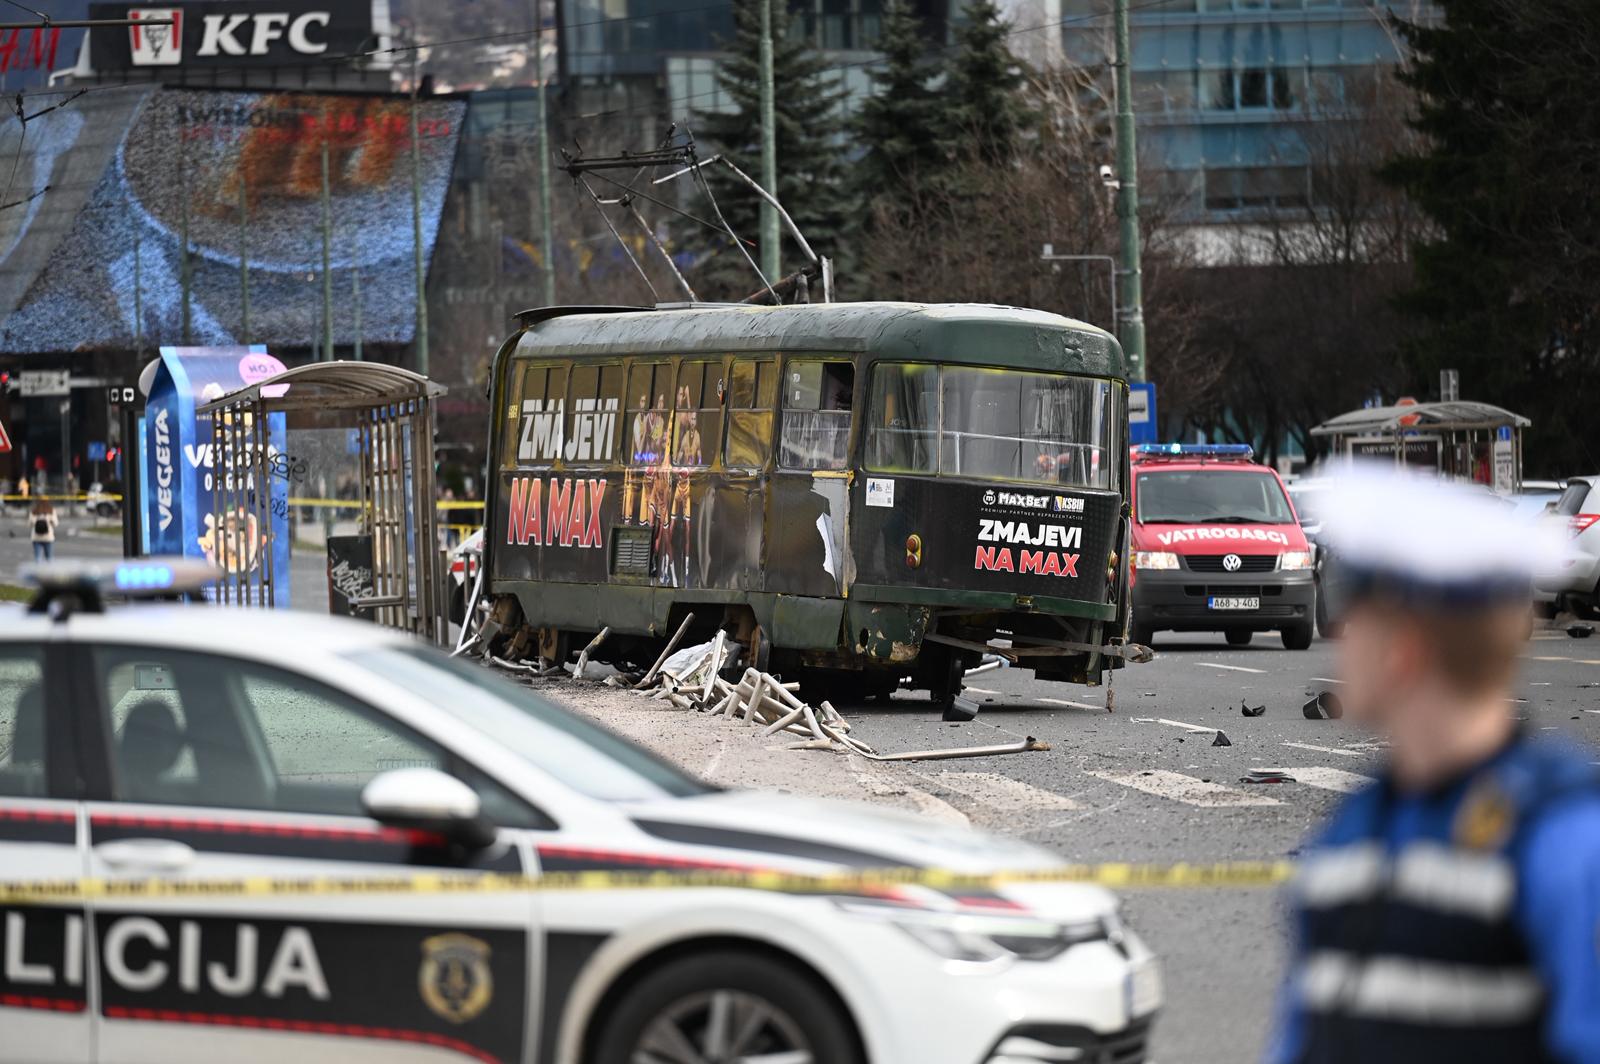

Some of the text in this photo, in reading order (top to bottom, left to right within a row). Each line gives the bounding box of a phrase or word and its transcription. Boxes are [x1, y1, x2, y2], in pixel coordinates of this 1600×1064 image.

[196, 12, 330, 56] KFC
[518, 398, 619, 462] ZMAJEVI
[155, 408, 174, 532] VEGETA
[507, 477, 607, 548] NA MAX
[978, 519, 1082, 549] ZMAJEVI
[1157, 528, 1289, 545] VATROGASCI
[975, 545, 1080, 577] NA MAX
[1214, 598, 1258, 609] A68-J-403
[5, 911, 331, 1000] LICIJA
